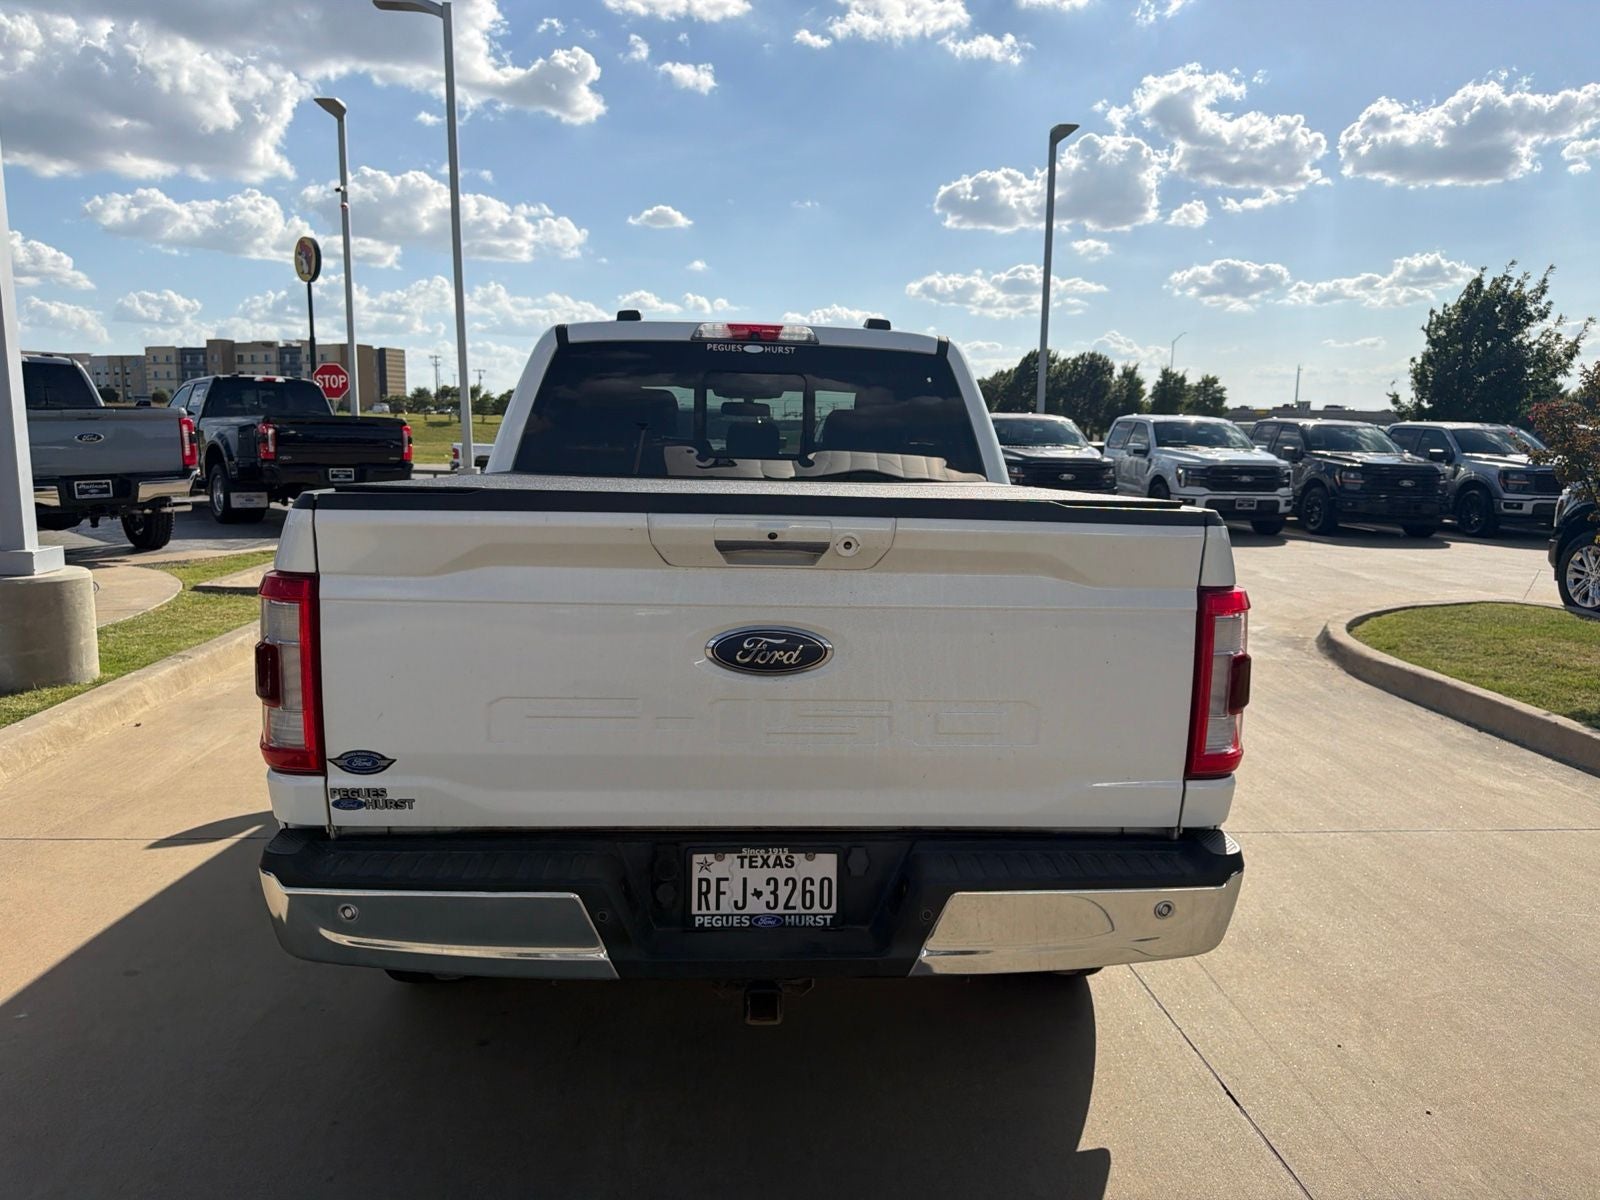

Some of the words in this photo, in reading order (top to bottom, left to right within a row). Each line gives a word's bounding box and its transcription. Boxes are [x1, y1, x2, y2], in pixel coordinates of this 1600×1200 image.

[706, 343, 742, 352] PEGUES
[764, 346, 796, 354] HURST
[316, 375, 347, 388] STOP
[735, 636, 803, 664] Ford
[351, 757, 373, 768] Ford
[329, 787, 388, 799] PEGUES
[365, 798, 416, 810] HURST
[741, 847, 766, 855] Since
[768, 847, 789, 855] 1915
[736, 855, 795, 869] TEXAS
[697, 877, 748, 911] RFJ
[765, 876, 833, 911] 3260
[694, 915, 750, 927] PEGUES
[785, 915, 833, 927] HURST
